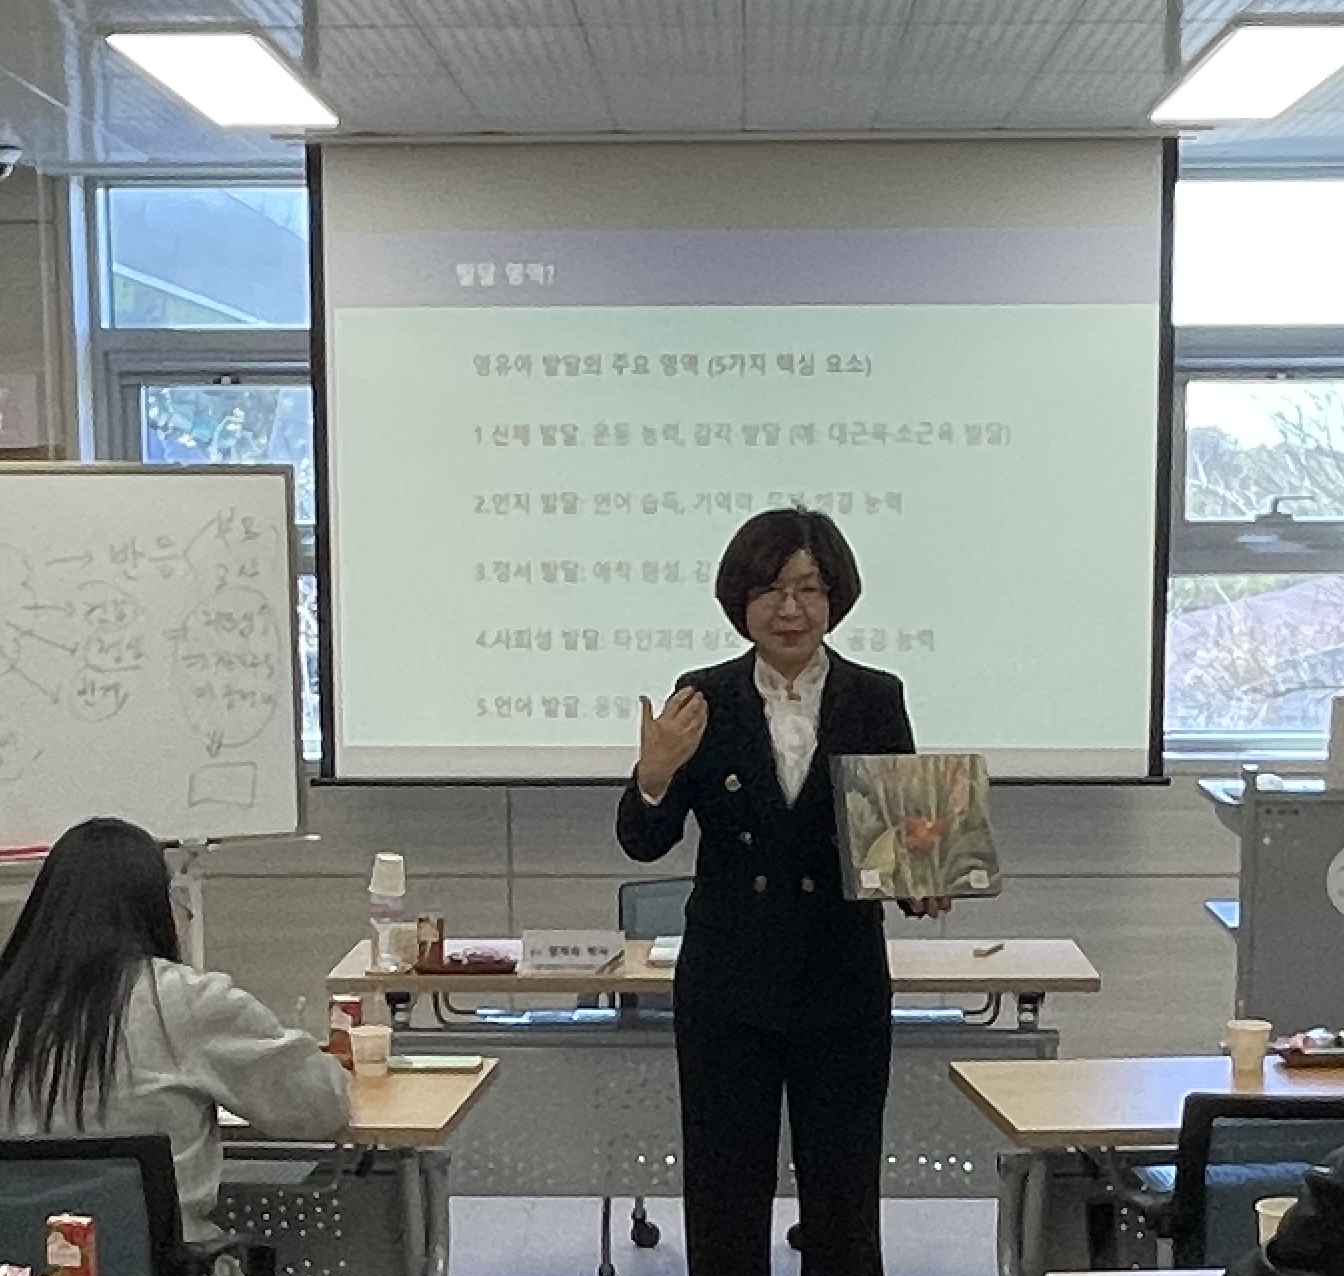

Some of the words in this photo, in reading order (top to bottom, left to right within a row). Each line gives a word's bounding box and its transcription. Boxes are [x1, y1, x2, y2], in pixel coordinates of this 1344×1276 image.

[542, 353, 603, 377] 발달의
[612, 352, 651, 377] 주요
[825, 353, 872, 379] 요소)
